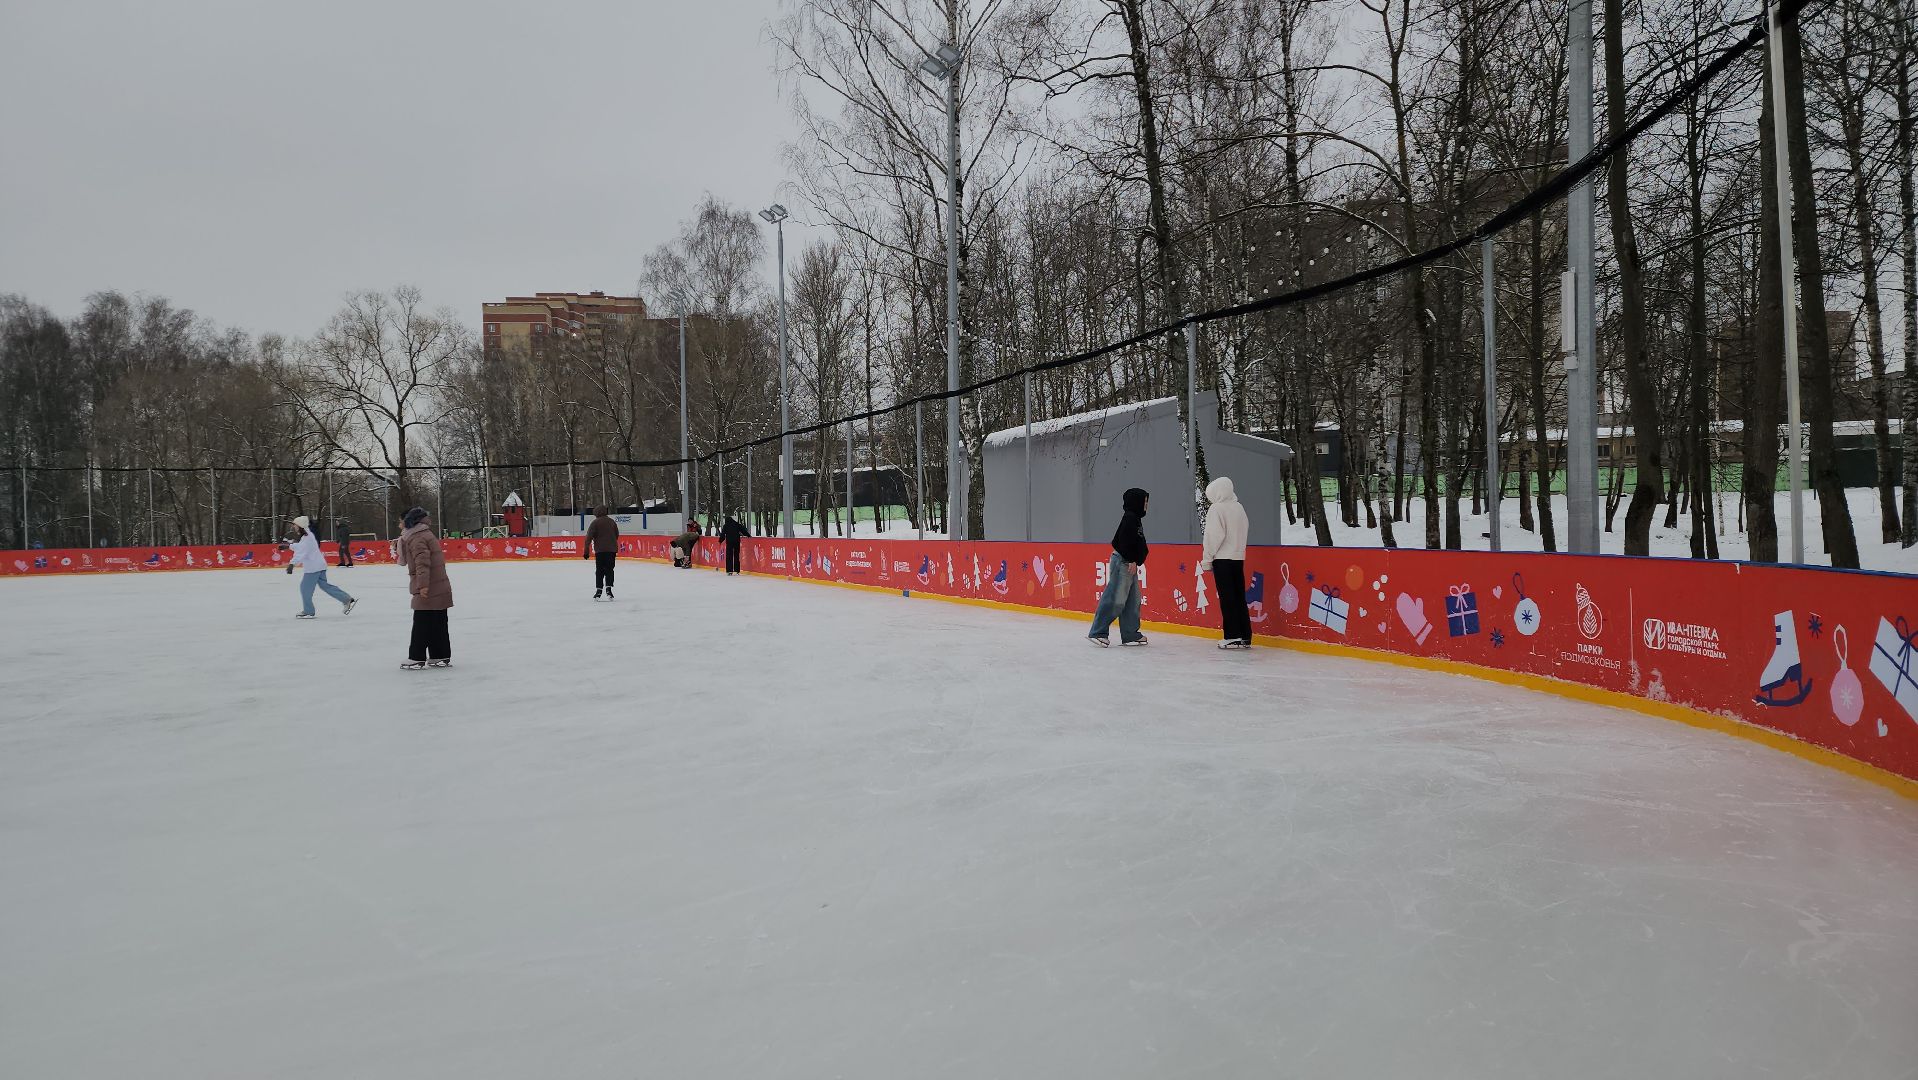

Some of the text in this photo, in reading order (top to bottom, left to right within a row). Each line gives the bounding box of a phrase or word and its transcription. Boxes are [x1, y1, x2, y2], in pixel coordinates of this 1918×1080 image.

[1577, 643, 1603, 656] ПАРКИ
[1667, 643, 1696, 654] КУЛЬТУРЫ
[1703, 640, 1720, 651] ПАРК
